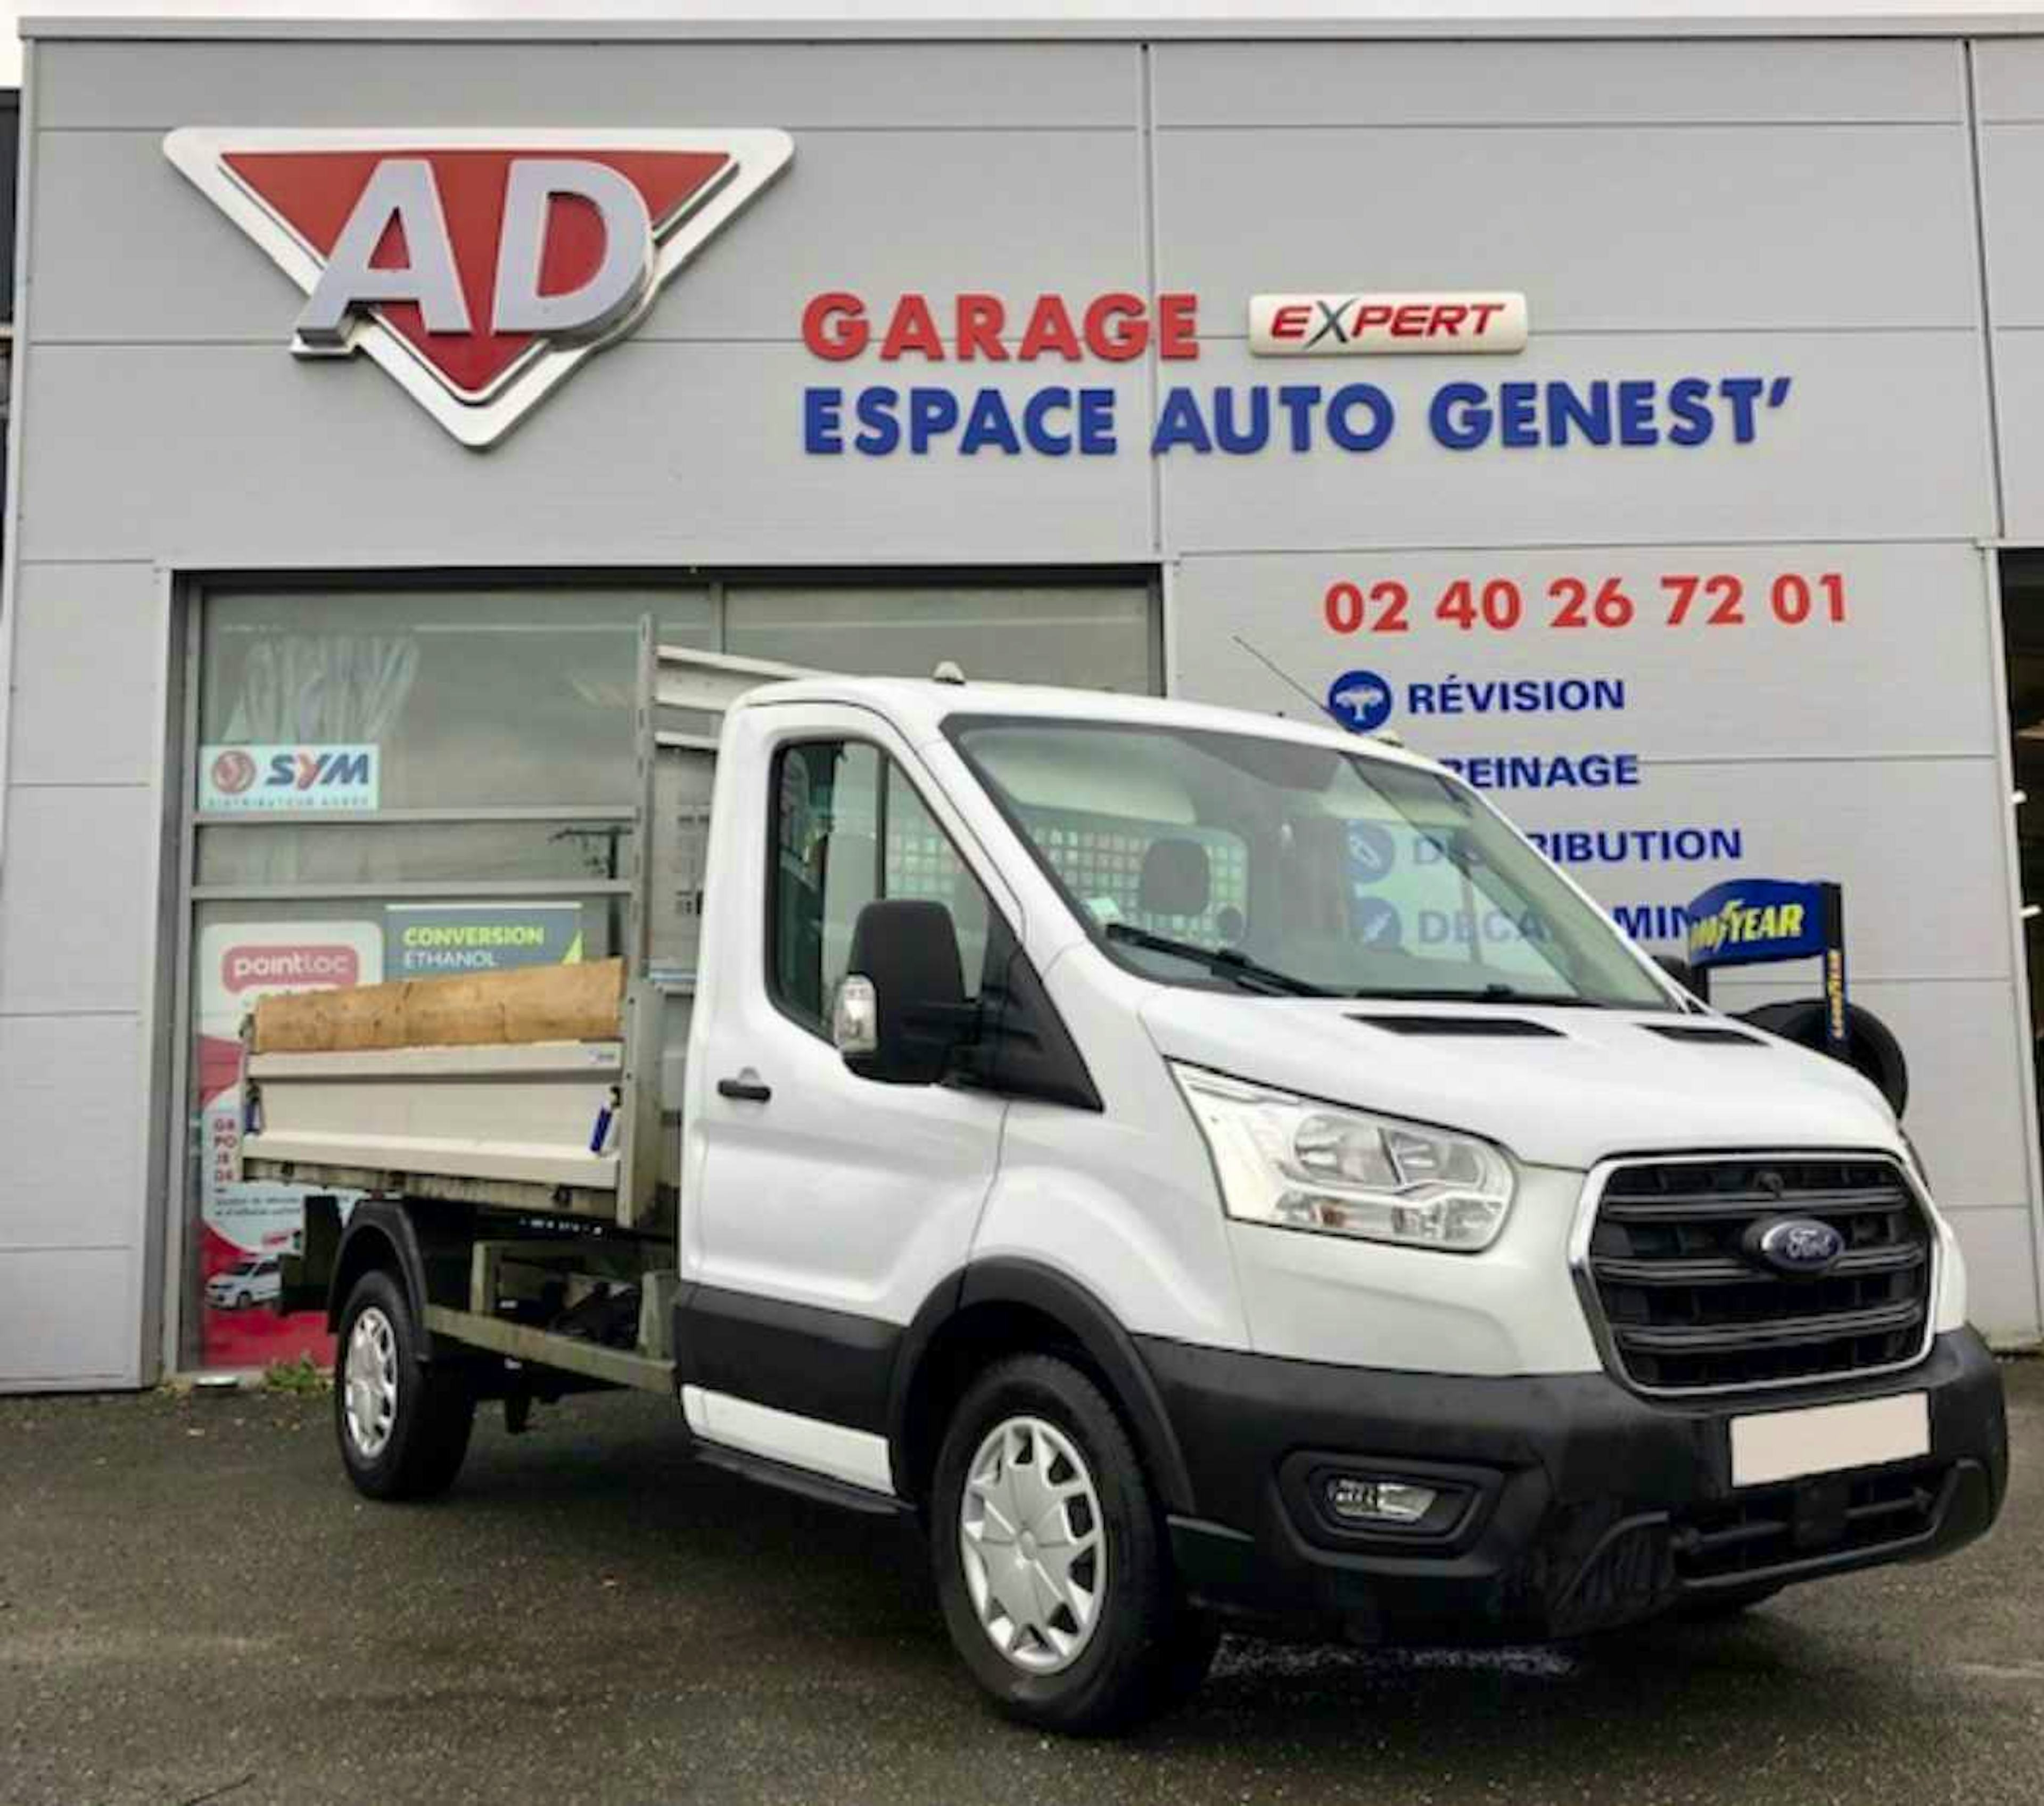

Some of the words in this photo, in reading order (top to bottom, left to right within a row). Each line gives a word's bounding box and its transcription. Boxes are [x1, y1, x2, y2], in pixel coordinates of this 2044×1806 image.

[294, 158, 655, 346] AD
[802, 292, 1199, 362] GARAGE
[1270, 299, 1504, 349] EXPERT
[803, 385, 1118, 456] ESPACE
[1152, 381, 1395, 455] AUTO
[1324, 580, 1409, 635] 02
[1435, 578, 1522, 631] 40
[1547, 576, 1634, 629] 26
[1662, 573, 1746, 628] 72
[1771, 572, 1846, 627] 01
[1408, 675, 1626, 715] RÉVISION
[265, 752, 369, 791] SYM
[1438, 754, 1640, 789] EINAGE
[403, 926, 545, 946] CONVERSION
